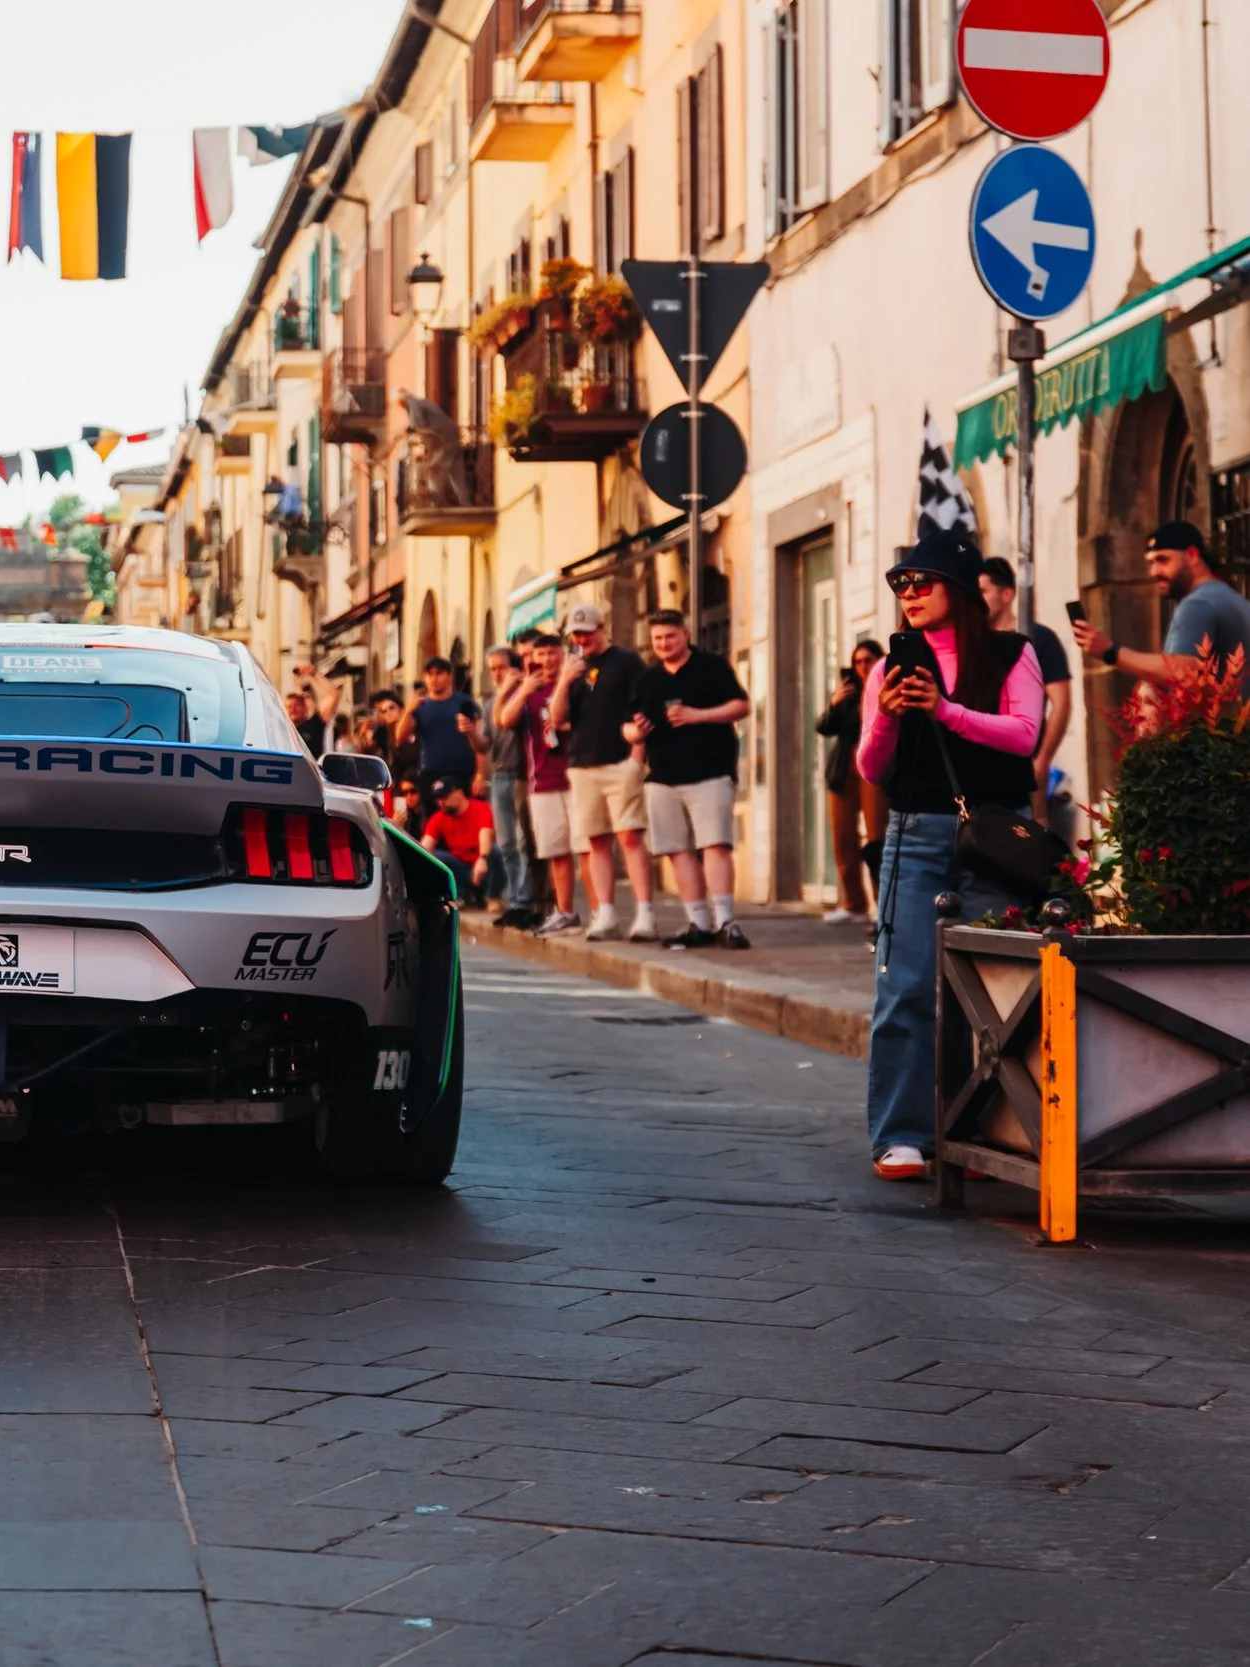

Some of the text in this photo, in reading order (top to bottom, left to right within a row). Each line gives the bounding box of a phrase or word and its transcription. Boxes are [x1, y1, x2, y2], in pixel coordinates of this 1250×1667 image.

[992, 344, 1111, 441] OROFRUTTA
[9, 656, 97, 667] DEANE
[241, 928, 339, 967] ECU
[234, 967, 317, 981] MASTER
[373, 1051, 411, 1090] 130
